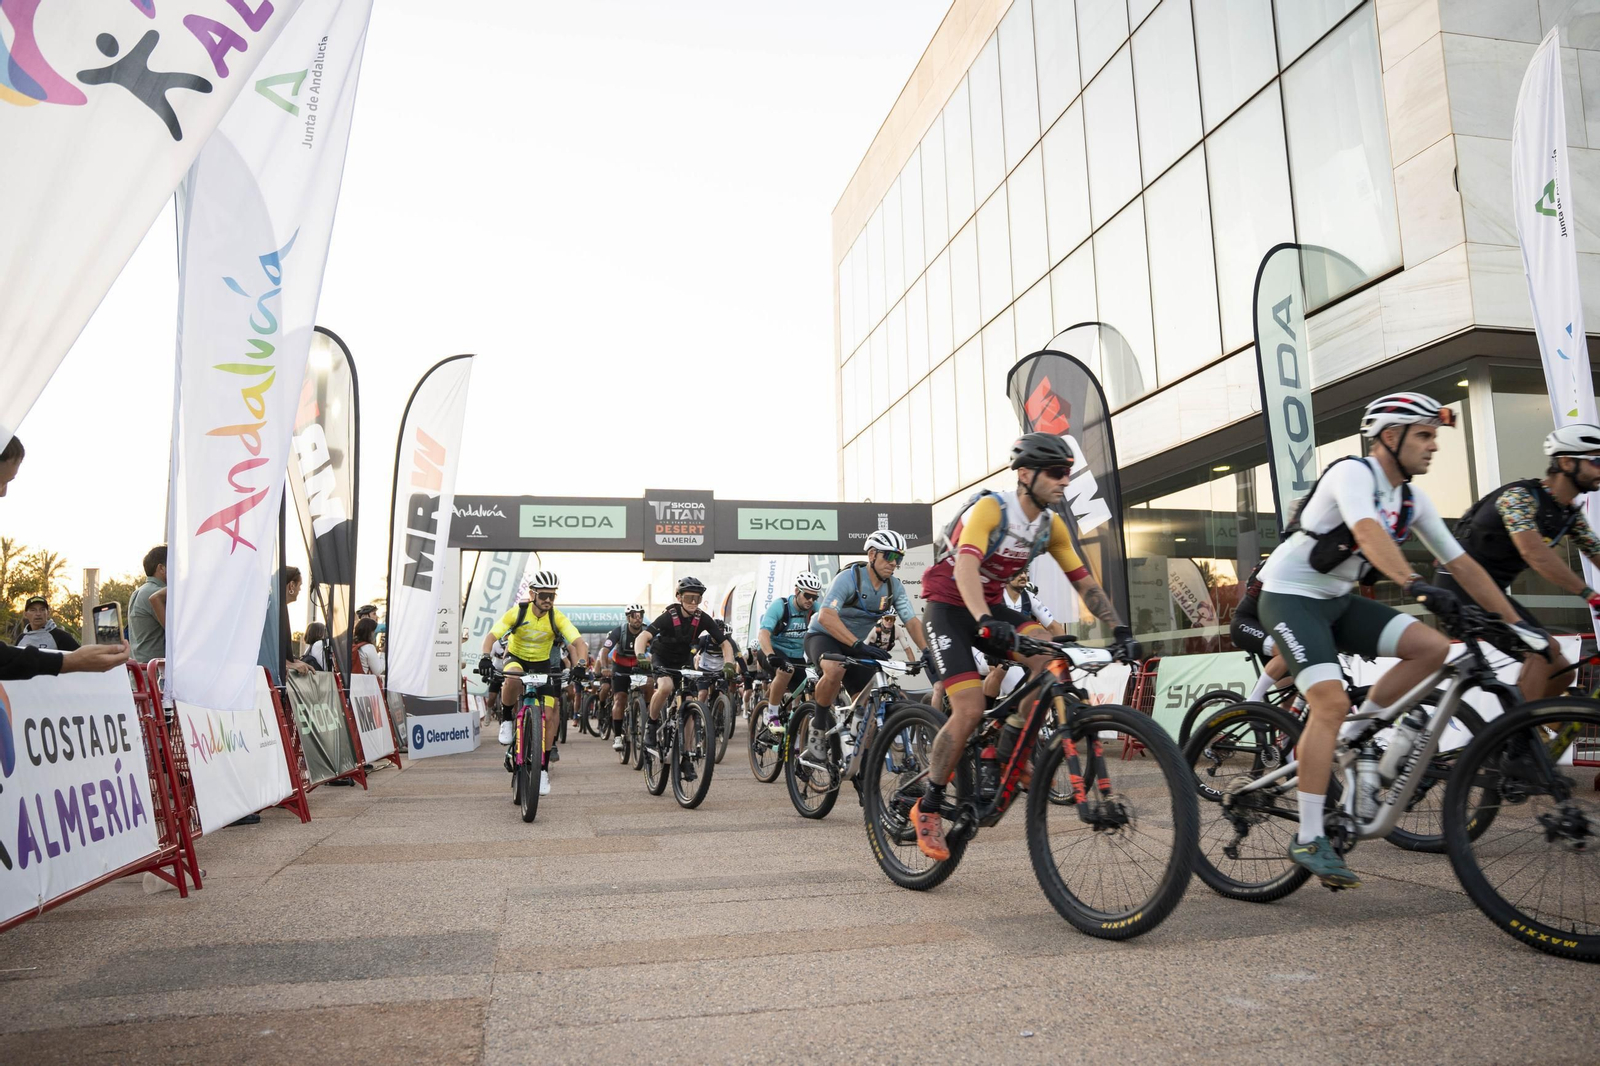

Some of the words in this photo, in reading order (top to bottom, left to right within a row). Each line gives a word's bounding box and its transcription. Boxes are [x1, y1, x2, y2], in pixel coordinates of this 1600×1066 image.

[309, 35, 328, 94] Andalucía
[307, 94, 319, 112] de
[302, 111, 316, 149] Junta
[1558, 211, 1568, 238] Junta
[195, 226, 300, 555] Andalucía
[1272, 293, 1318, 490] KODA
[403, 427, 446, 592] MRW
[452, 503, 507, 519] Andalucía
[648, 501, 705, 520] TITAN
[655, 525, 705, 534] DESERT
[662, 535, 697, 544] ALMERÍA
[473, 551, 513, 637] SKOD
[765, 560, 777, 609] Cleardent
[1273, 621, 1309, 664] primaflor
[354, 694, 383, 733] MRW
[24, 714, 104, 766] COSTA
[104, 713, 132, 754] DE
[187, 710, 250, 765] Andalucía
[426, 726, 470, 743] Cleardent
[18, 757, 148, 870] ALMERÍA
[1101, 911, 1143, 930] MAXXIS
[1509, 919, 1579, 948] MAXXIS
